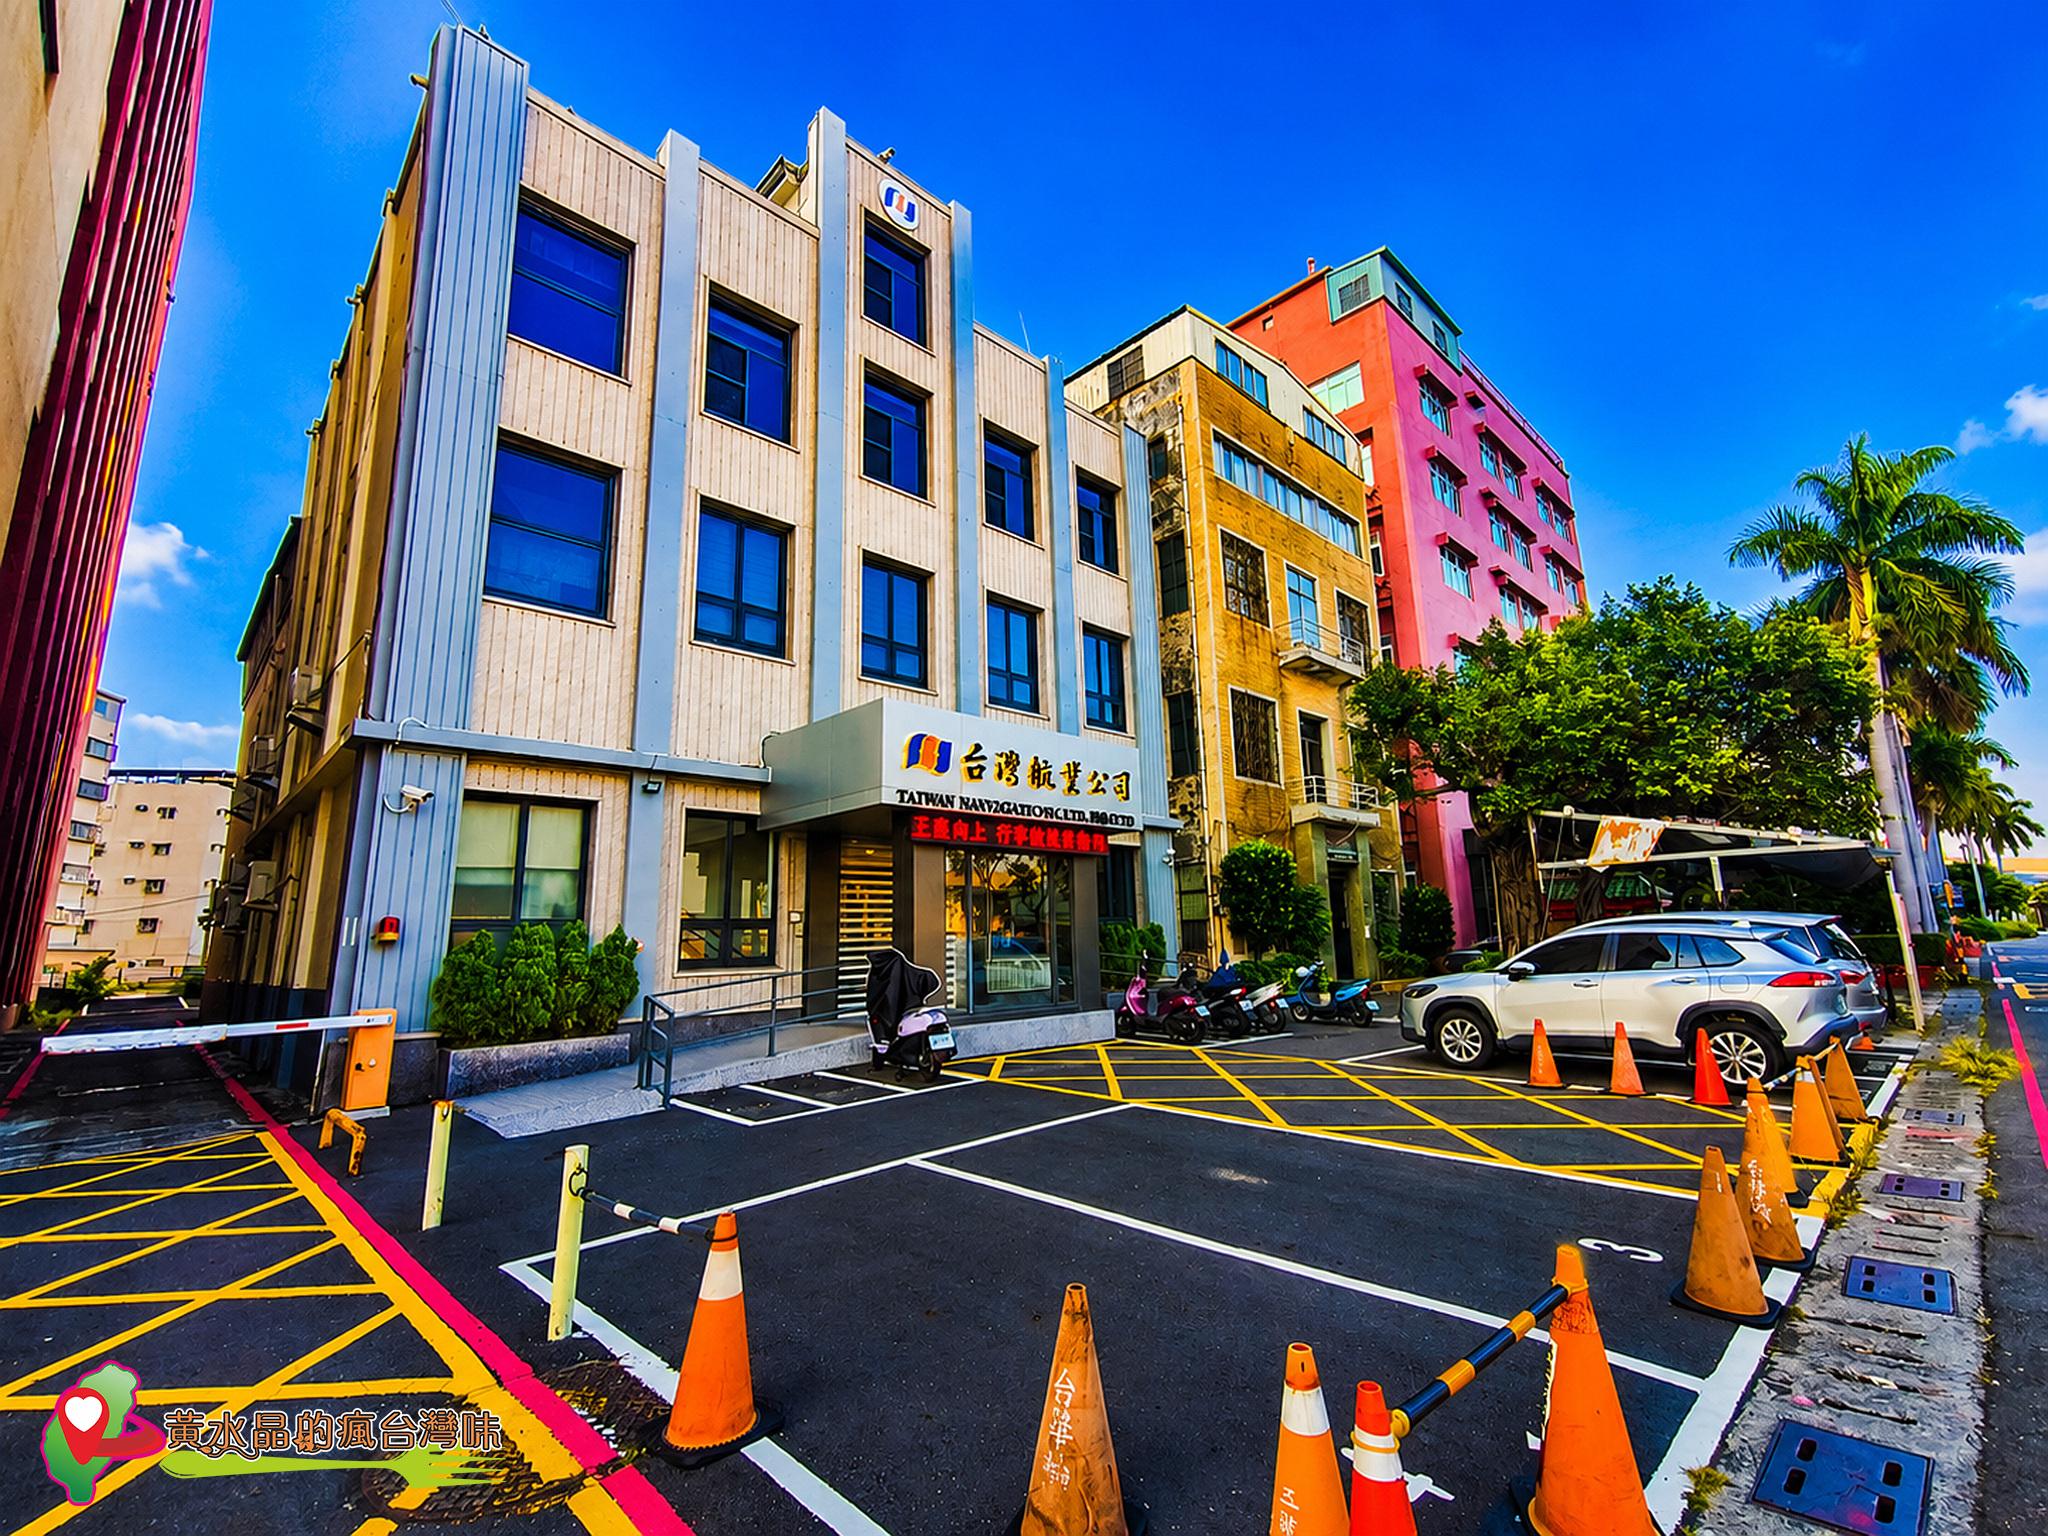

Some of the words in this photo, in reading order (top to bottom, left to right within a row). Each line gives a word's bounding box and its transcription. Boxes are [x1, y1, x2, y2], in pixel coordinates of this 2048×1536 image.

[960, 743, 1131, 802] 台灣航業公司
[896, 789, 956, 809] TAIWAN
